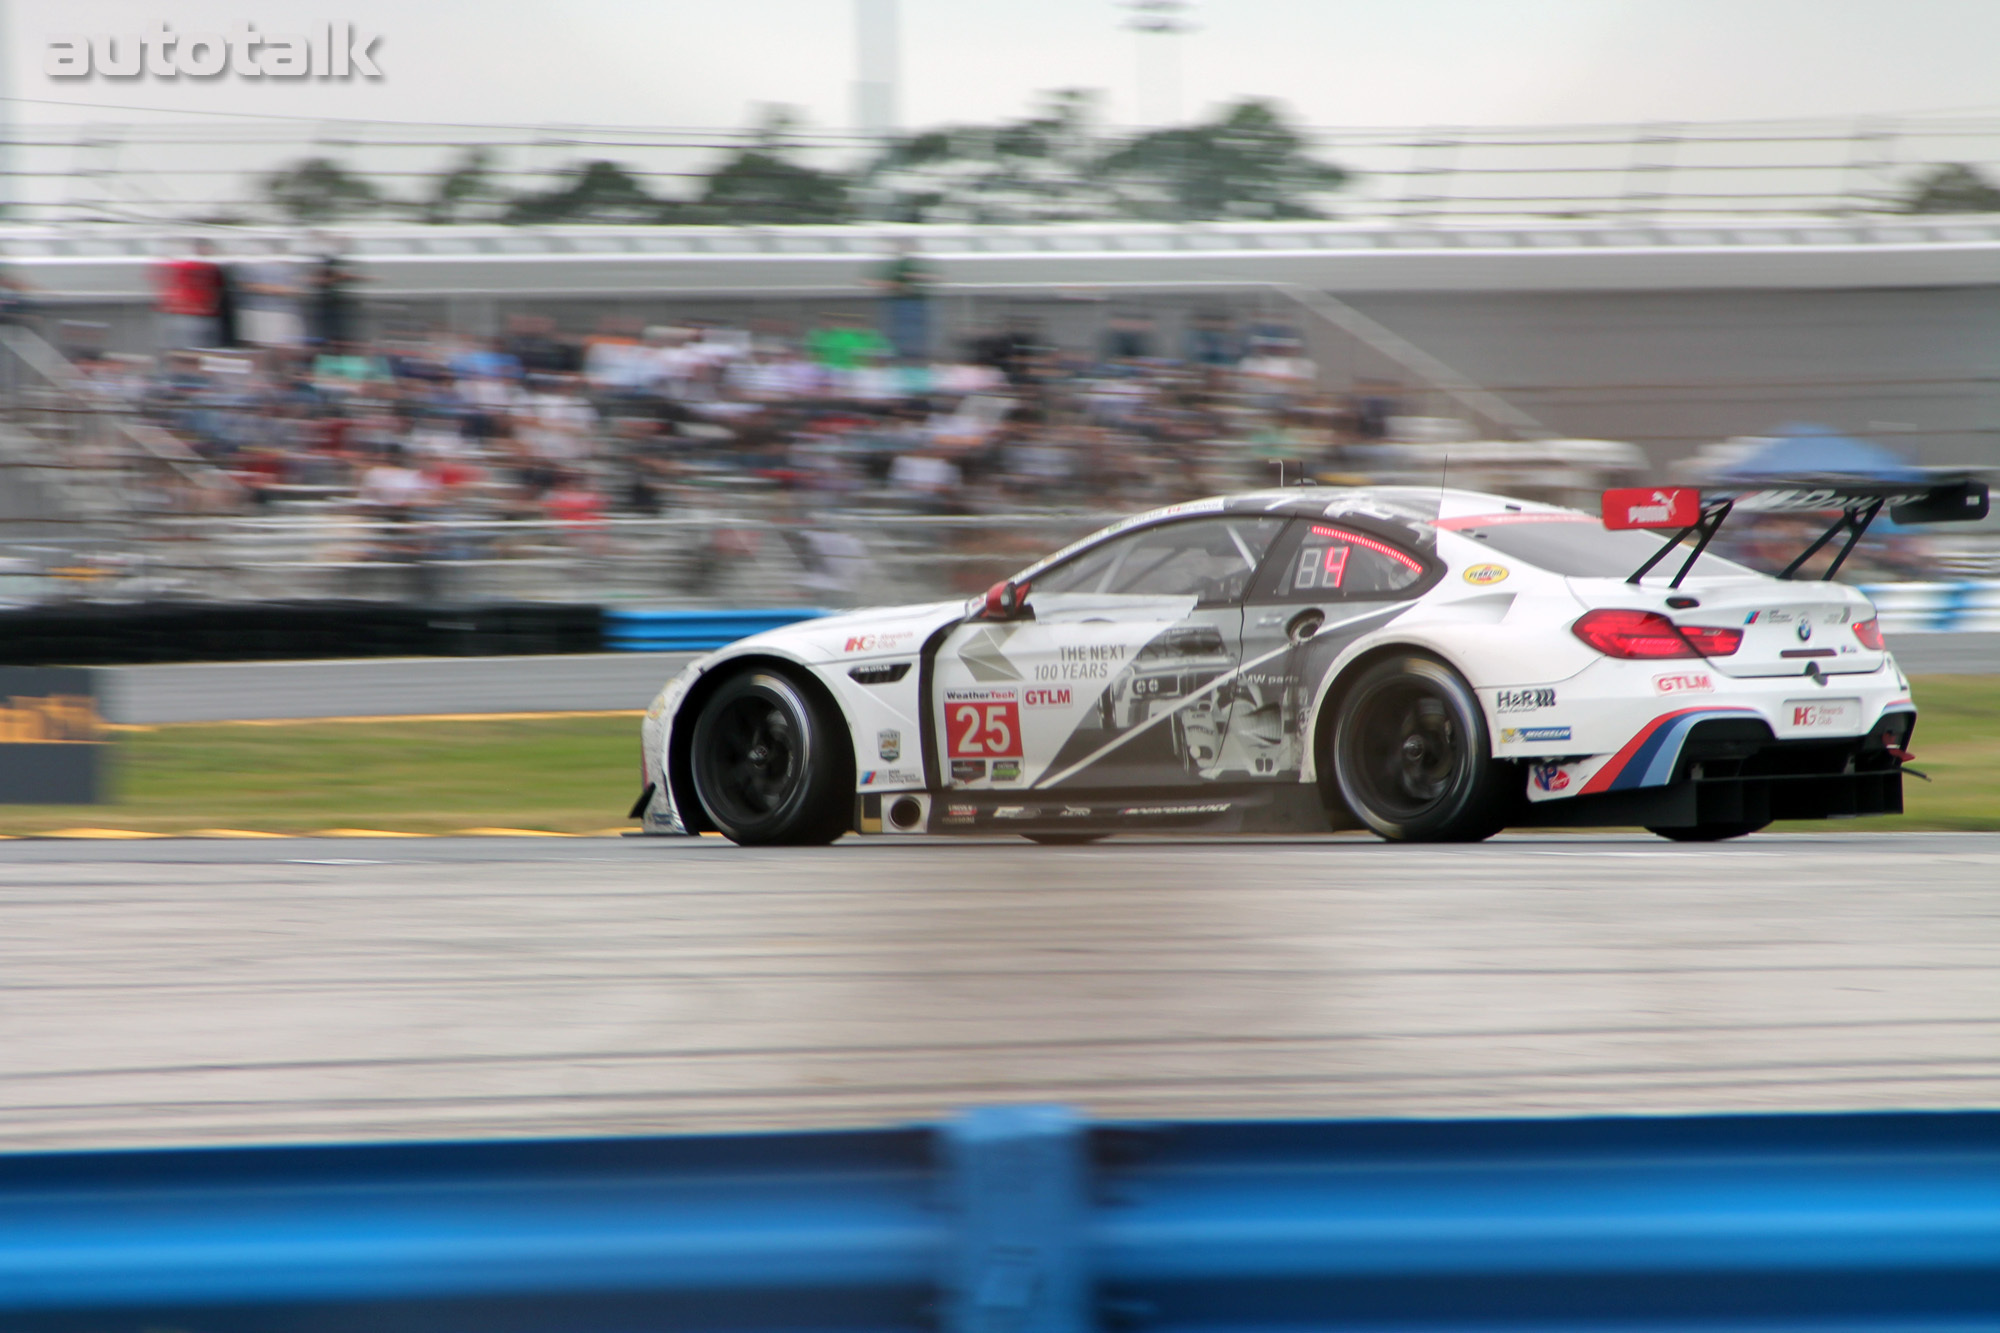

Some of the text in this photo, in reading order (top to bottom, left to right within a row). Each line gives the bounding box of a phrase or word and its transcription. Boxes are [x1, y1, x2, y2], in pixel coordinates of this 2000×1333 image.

[1628, 504, 1670, 524] PUMA
[1059, 644, 1127, 662] THE NEXT
[1034, 663, 1108, 681] 100 YEARS
[1657, 675, 1712, 692] GTLM
[946, 690, 1015, 700] WeatherTech
[1025, 689, 1071, 705] GTLM
[955, 705, 1011, 753] 25
[1525, 728, 1570, 738] MICHELIN
